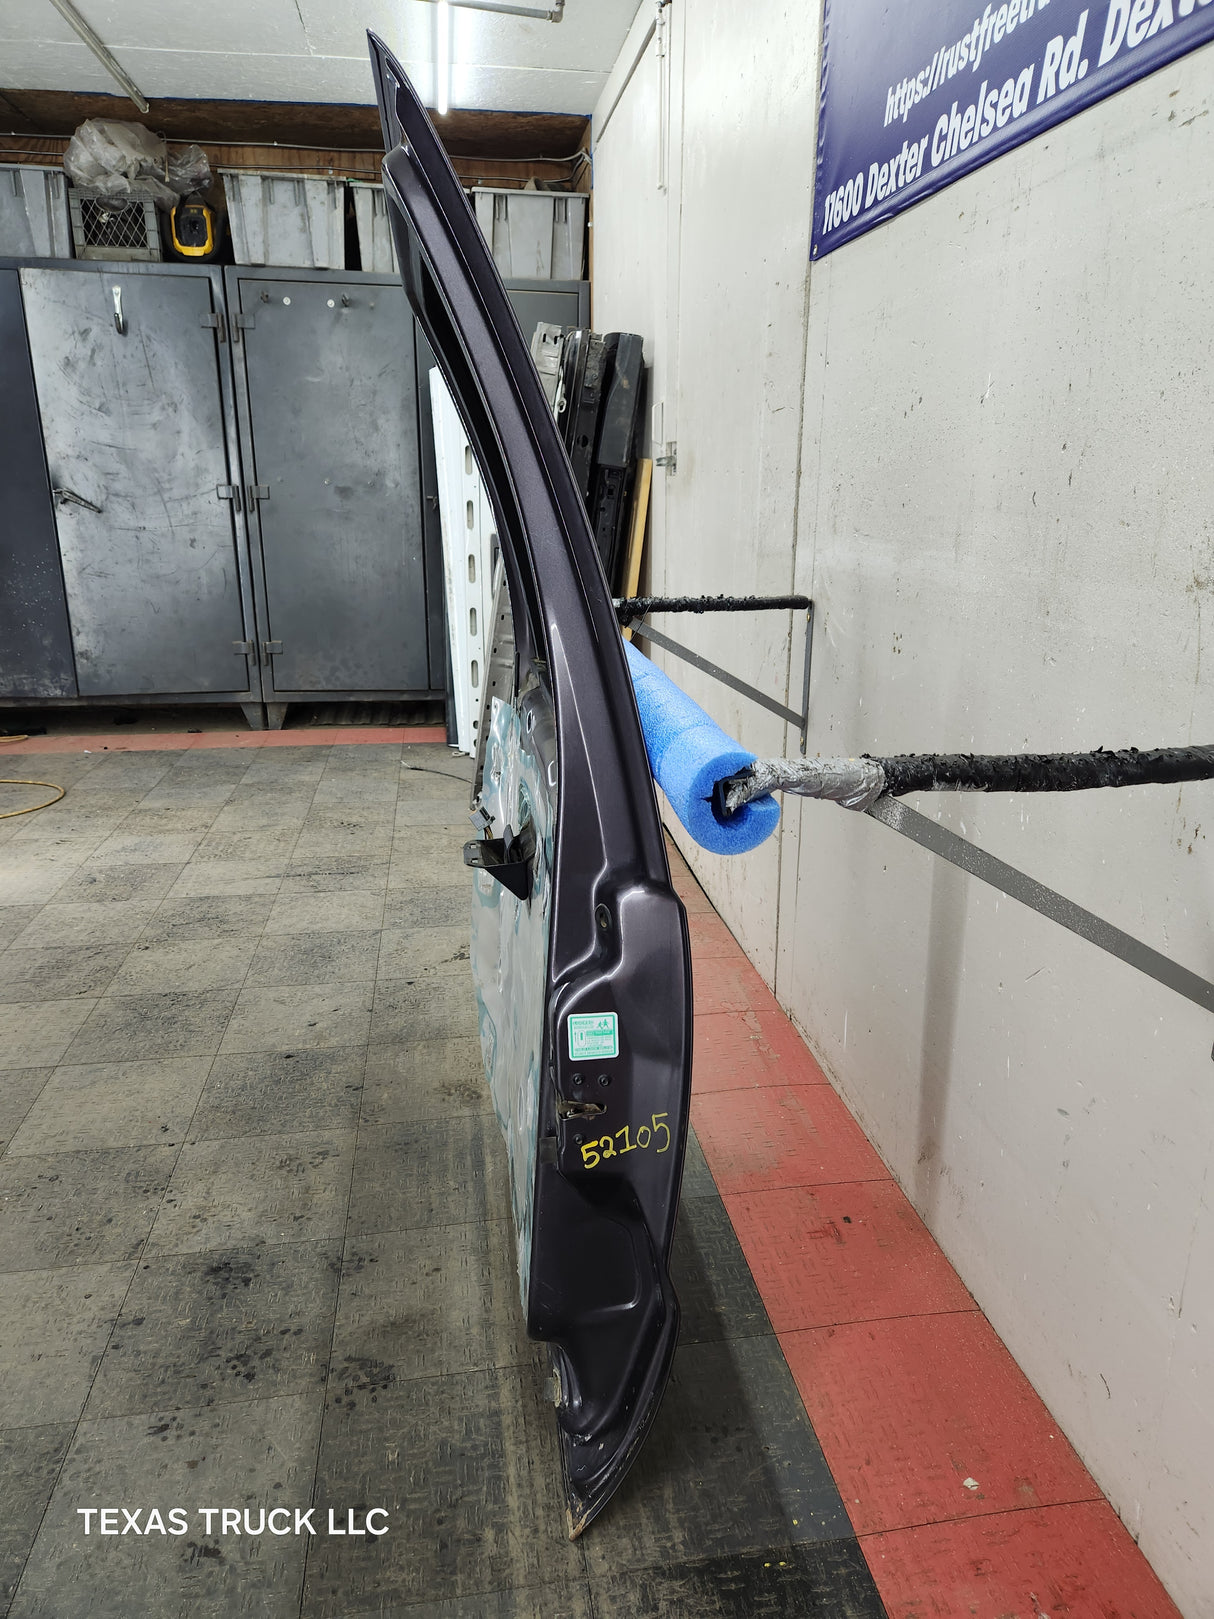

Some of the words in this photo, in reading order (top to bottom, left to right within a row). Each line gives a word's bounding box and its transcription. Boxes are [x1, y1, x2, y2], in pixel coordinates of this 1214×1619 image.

[865, 134, 929, 209] Dexter
[931, 63, 1035, 167] Chelsea
[1036, 8, 1088, 104] Rd.
[1098, 0, 1214, 68] Dex
[884, 0, 1050, 127] https://rustfree
[580, 1112, 671, 1169] 52105
